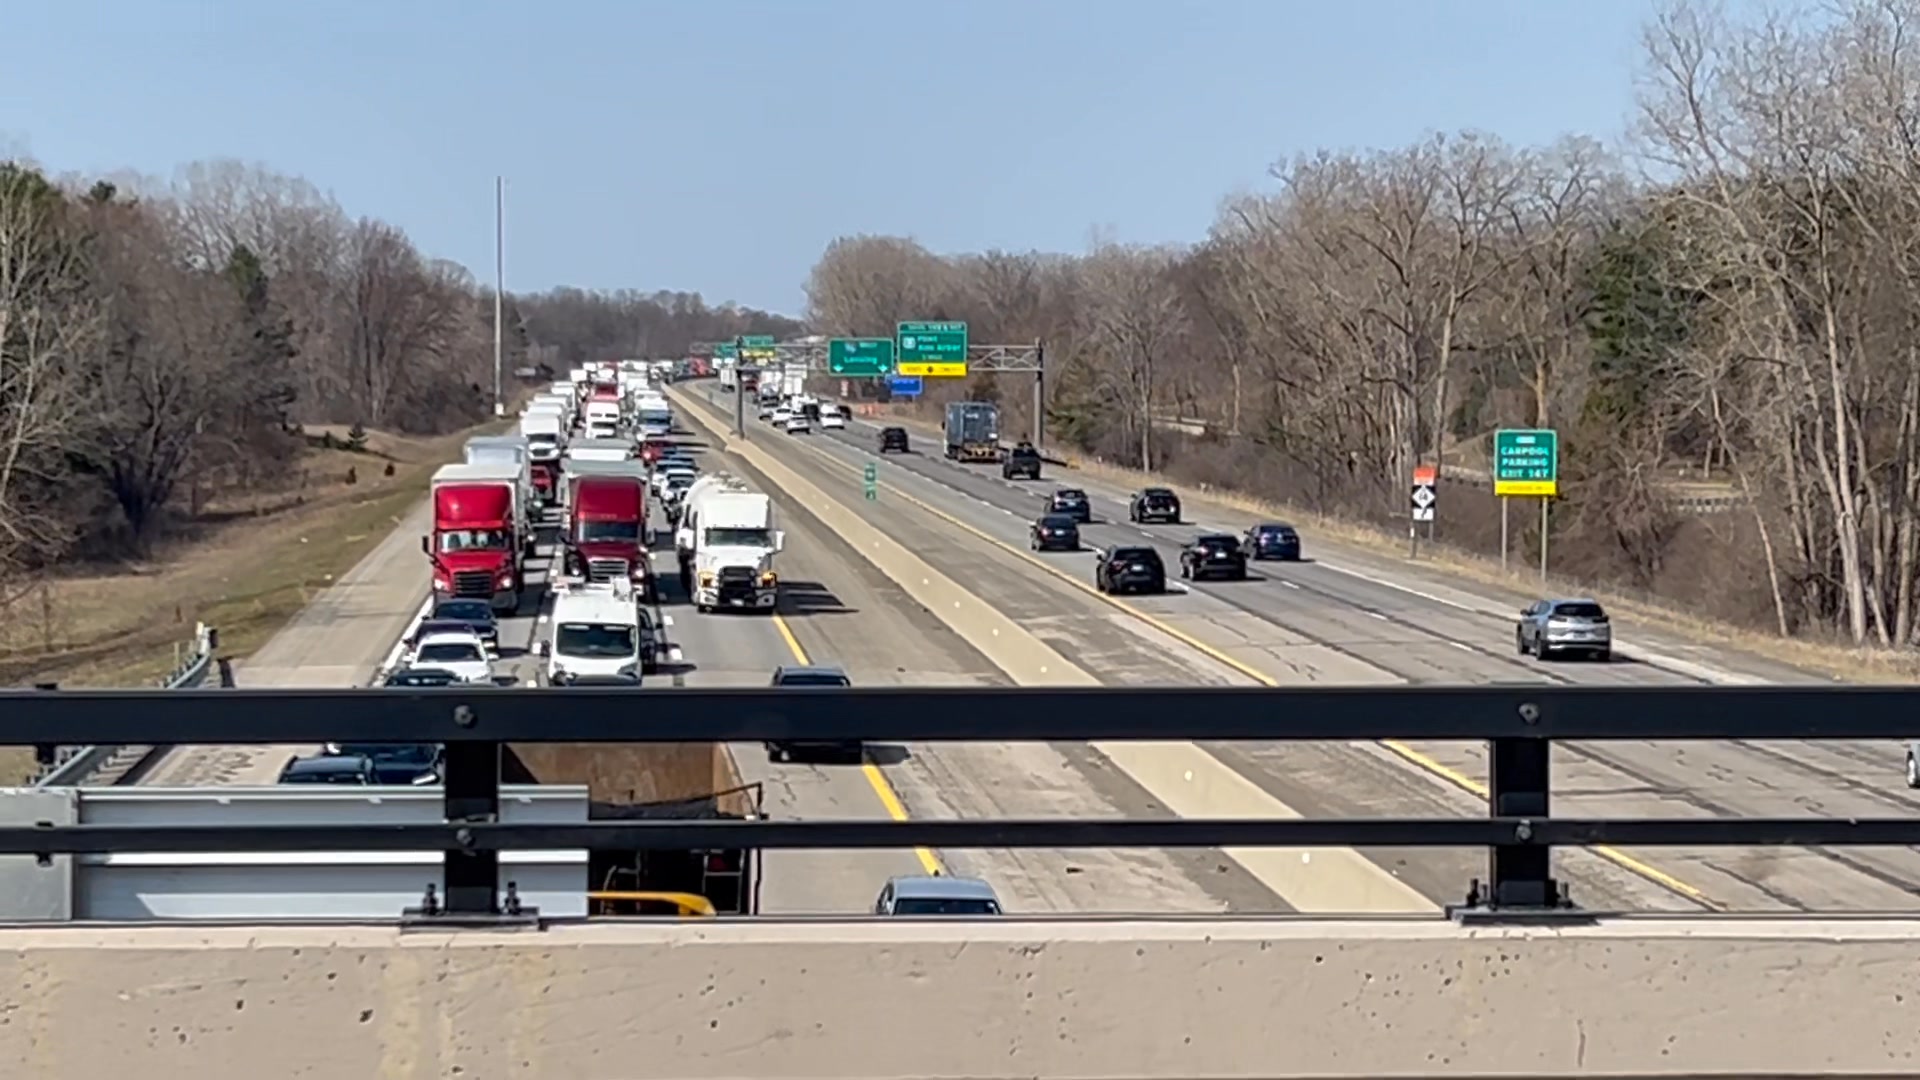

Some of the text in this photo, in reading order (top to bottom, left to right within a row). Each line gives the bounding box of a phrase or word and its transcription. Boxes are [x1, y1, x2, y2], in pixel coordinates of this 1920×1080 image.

[1501, 447, 1549, 456] CARPOOL
[1502, 458, 1548, 467] PARKING
[1501, 468, 1523, 478] EXIT
